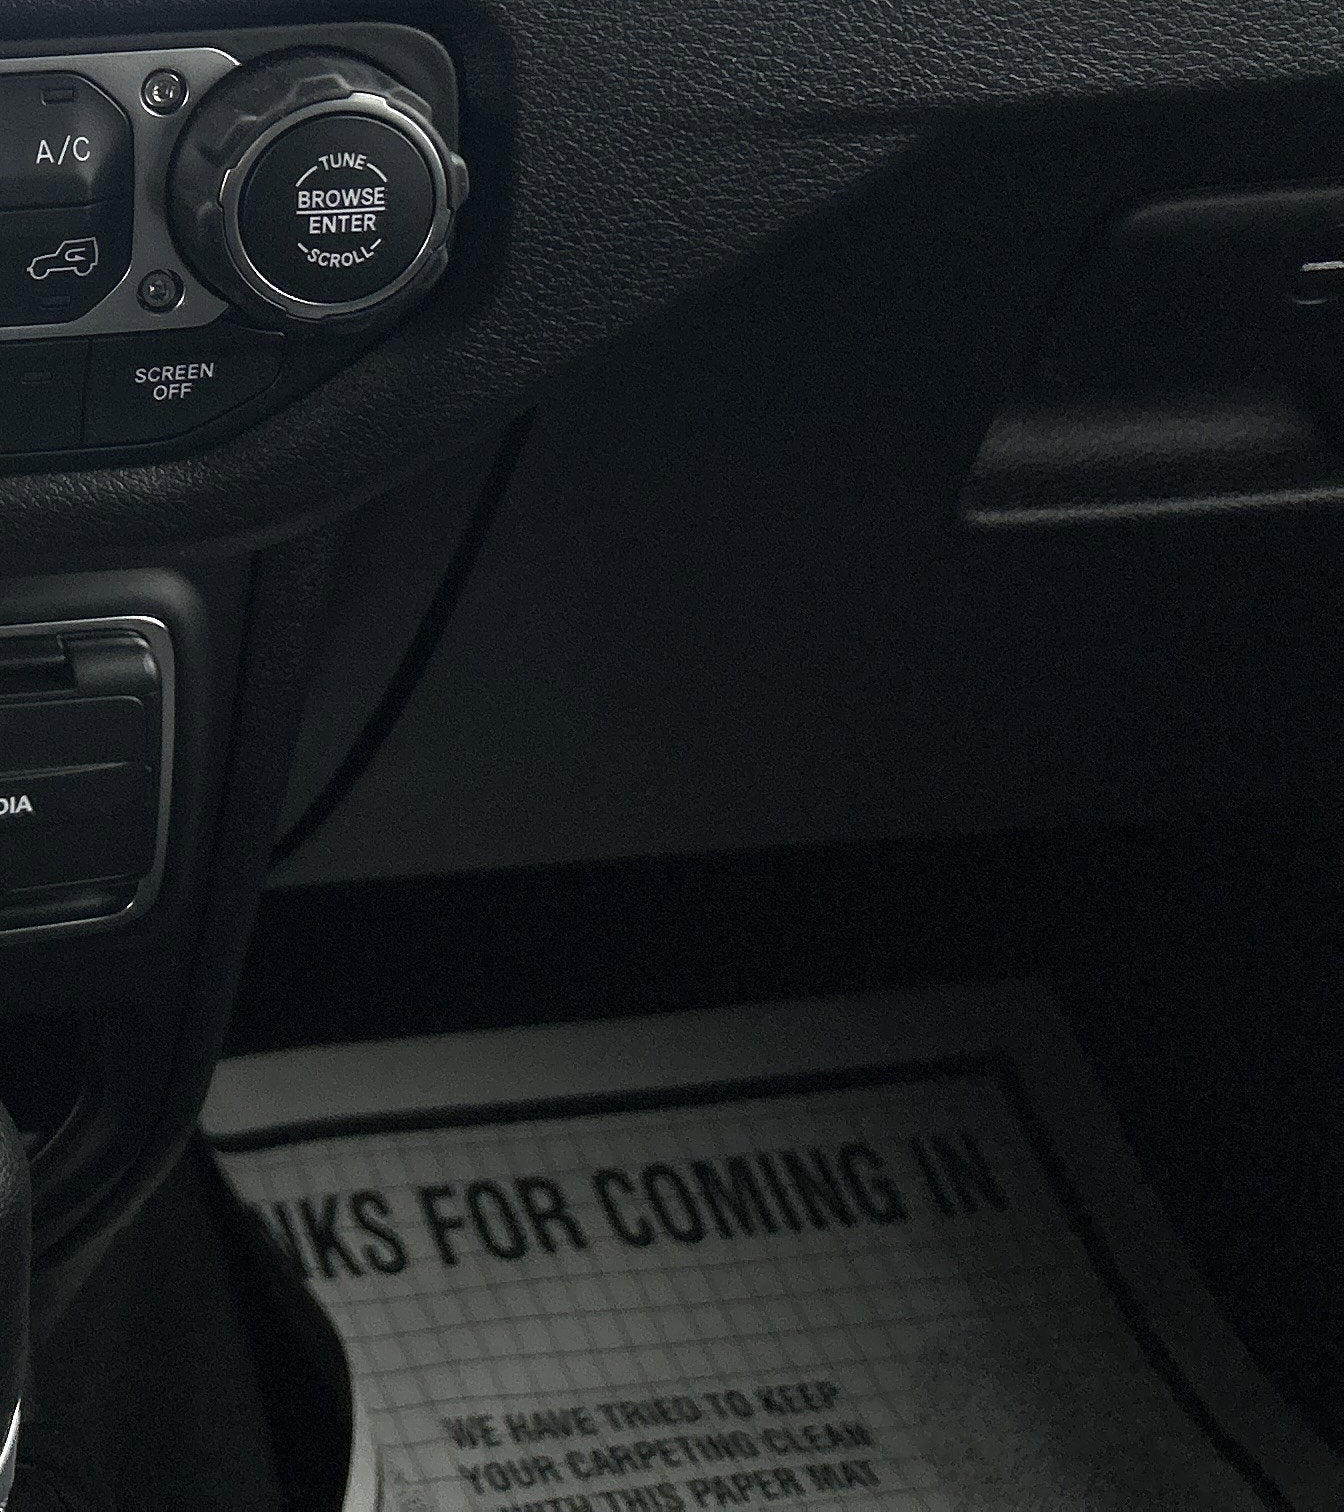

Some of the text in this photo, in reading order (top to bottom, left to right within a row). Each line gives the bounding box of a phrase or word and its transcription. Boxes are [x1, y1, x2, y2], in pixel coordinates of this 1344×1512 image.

[35, 135, 91, 166] A/C
[318, 152, 368, 171] TUNE
[296, 185, 386, 208] BROWSE
[307, 212, 377, 234] ENTER
[307, 246, 374, 268] SCROLL
[134, 362, 215, 386] SCREEN
[150, 380, 193, 401] OFF
[418, 1172, 588, 1268] FOR
[594, 1140, 908, 1248] COMING
[916, 1130, 1008, 1216] IN
[444, 1380, 842, 1450] WE HAVE TRIED TO KEEP
[458, 1456, 564, 1496] YOUR
[760, 1421, 876, 1456] CLEAN
[598, 1483, 686, 1512] THIS
[688, 1468, 808, 1508] PAPER
[808, 1460, 882, 1492] MAT
